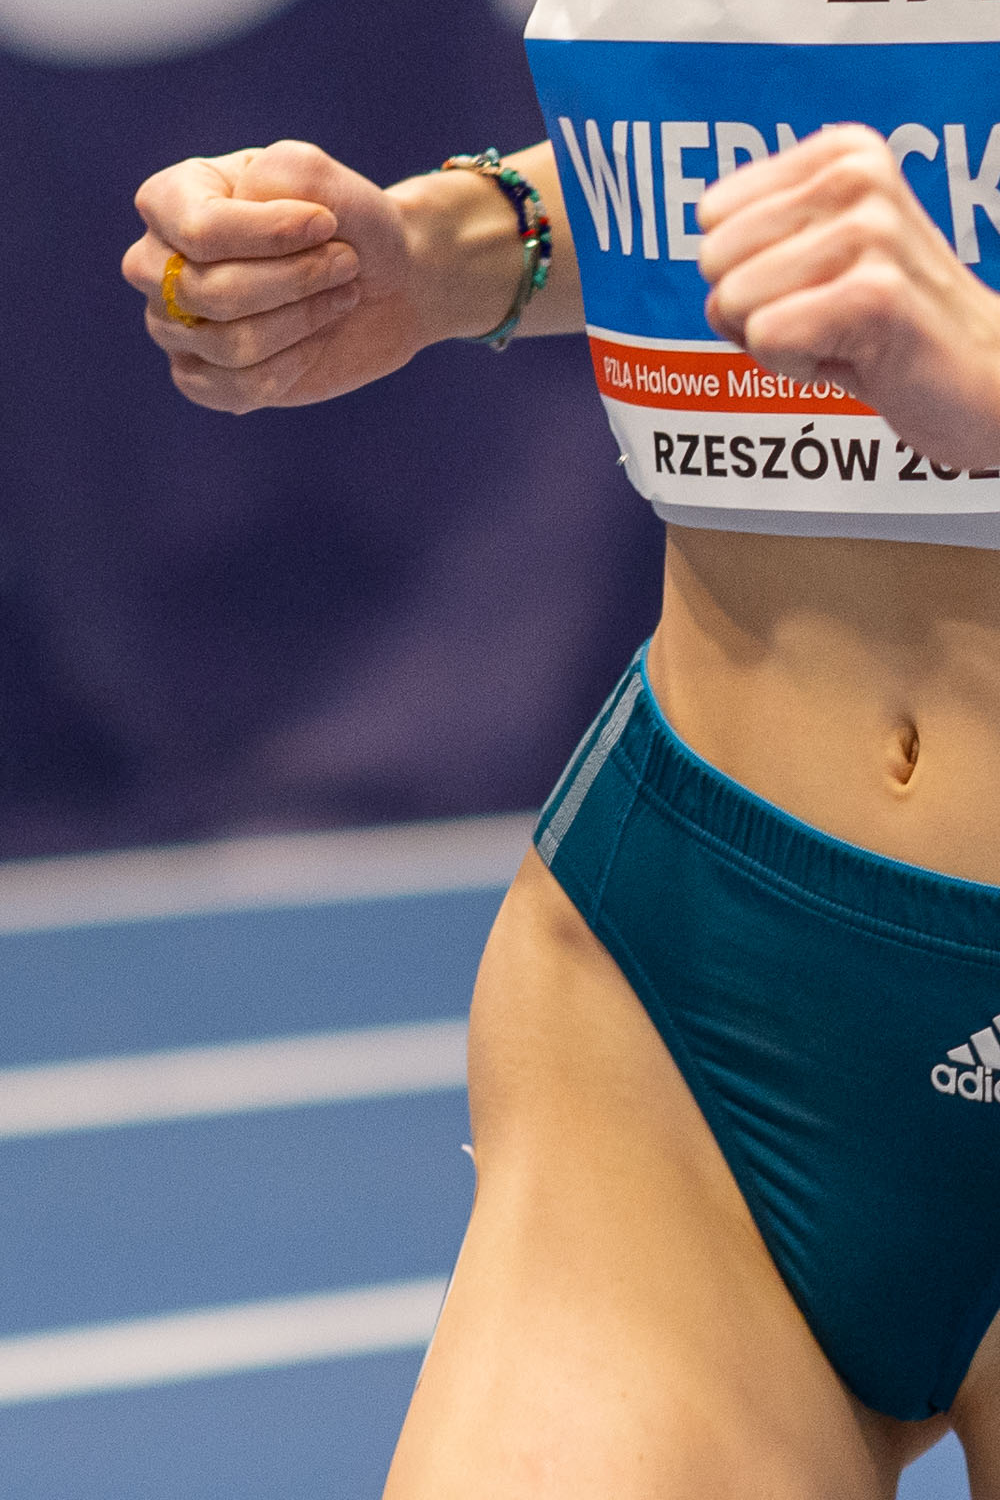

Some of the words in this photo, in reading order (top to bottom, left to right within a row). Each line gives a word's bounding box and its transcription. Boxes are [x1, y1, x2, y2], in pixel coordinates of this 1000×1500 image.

[603, 355, 633, 390] PZLA
[636, 364, 721, 397] Halowe
[653, 421, 881, 482] RZESZÓW
